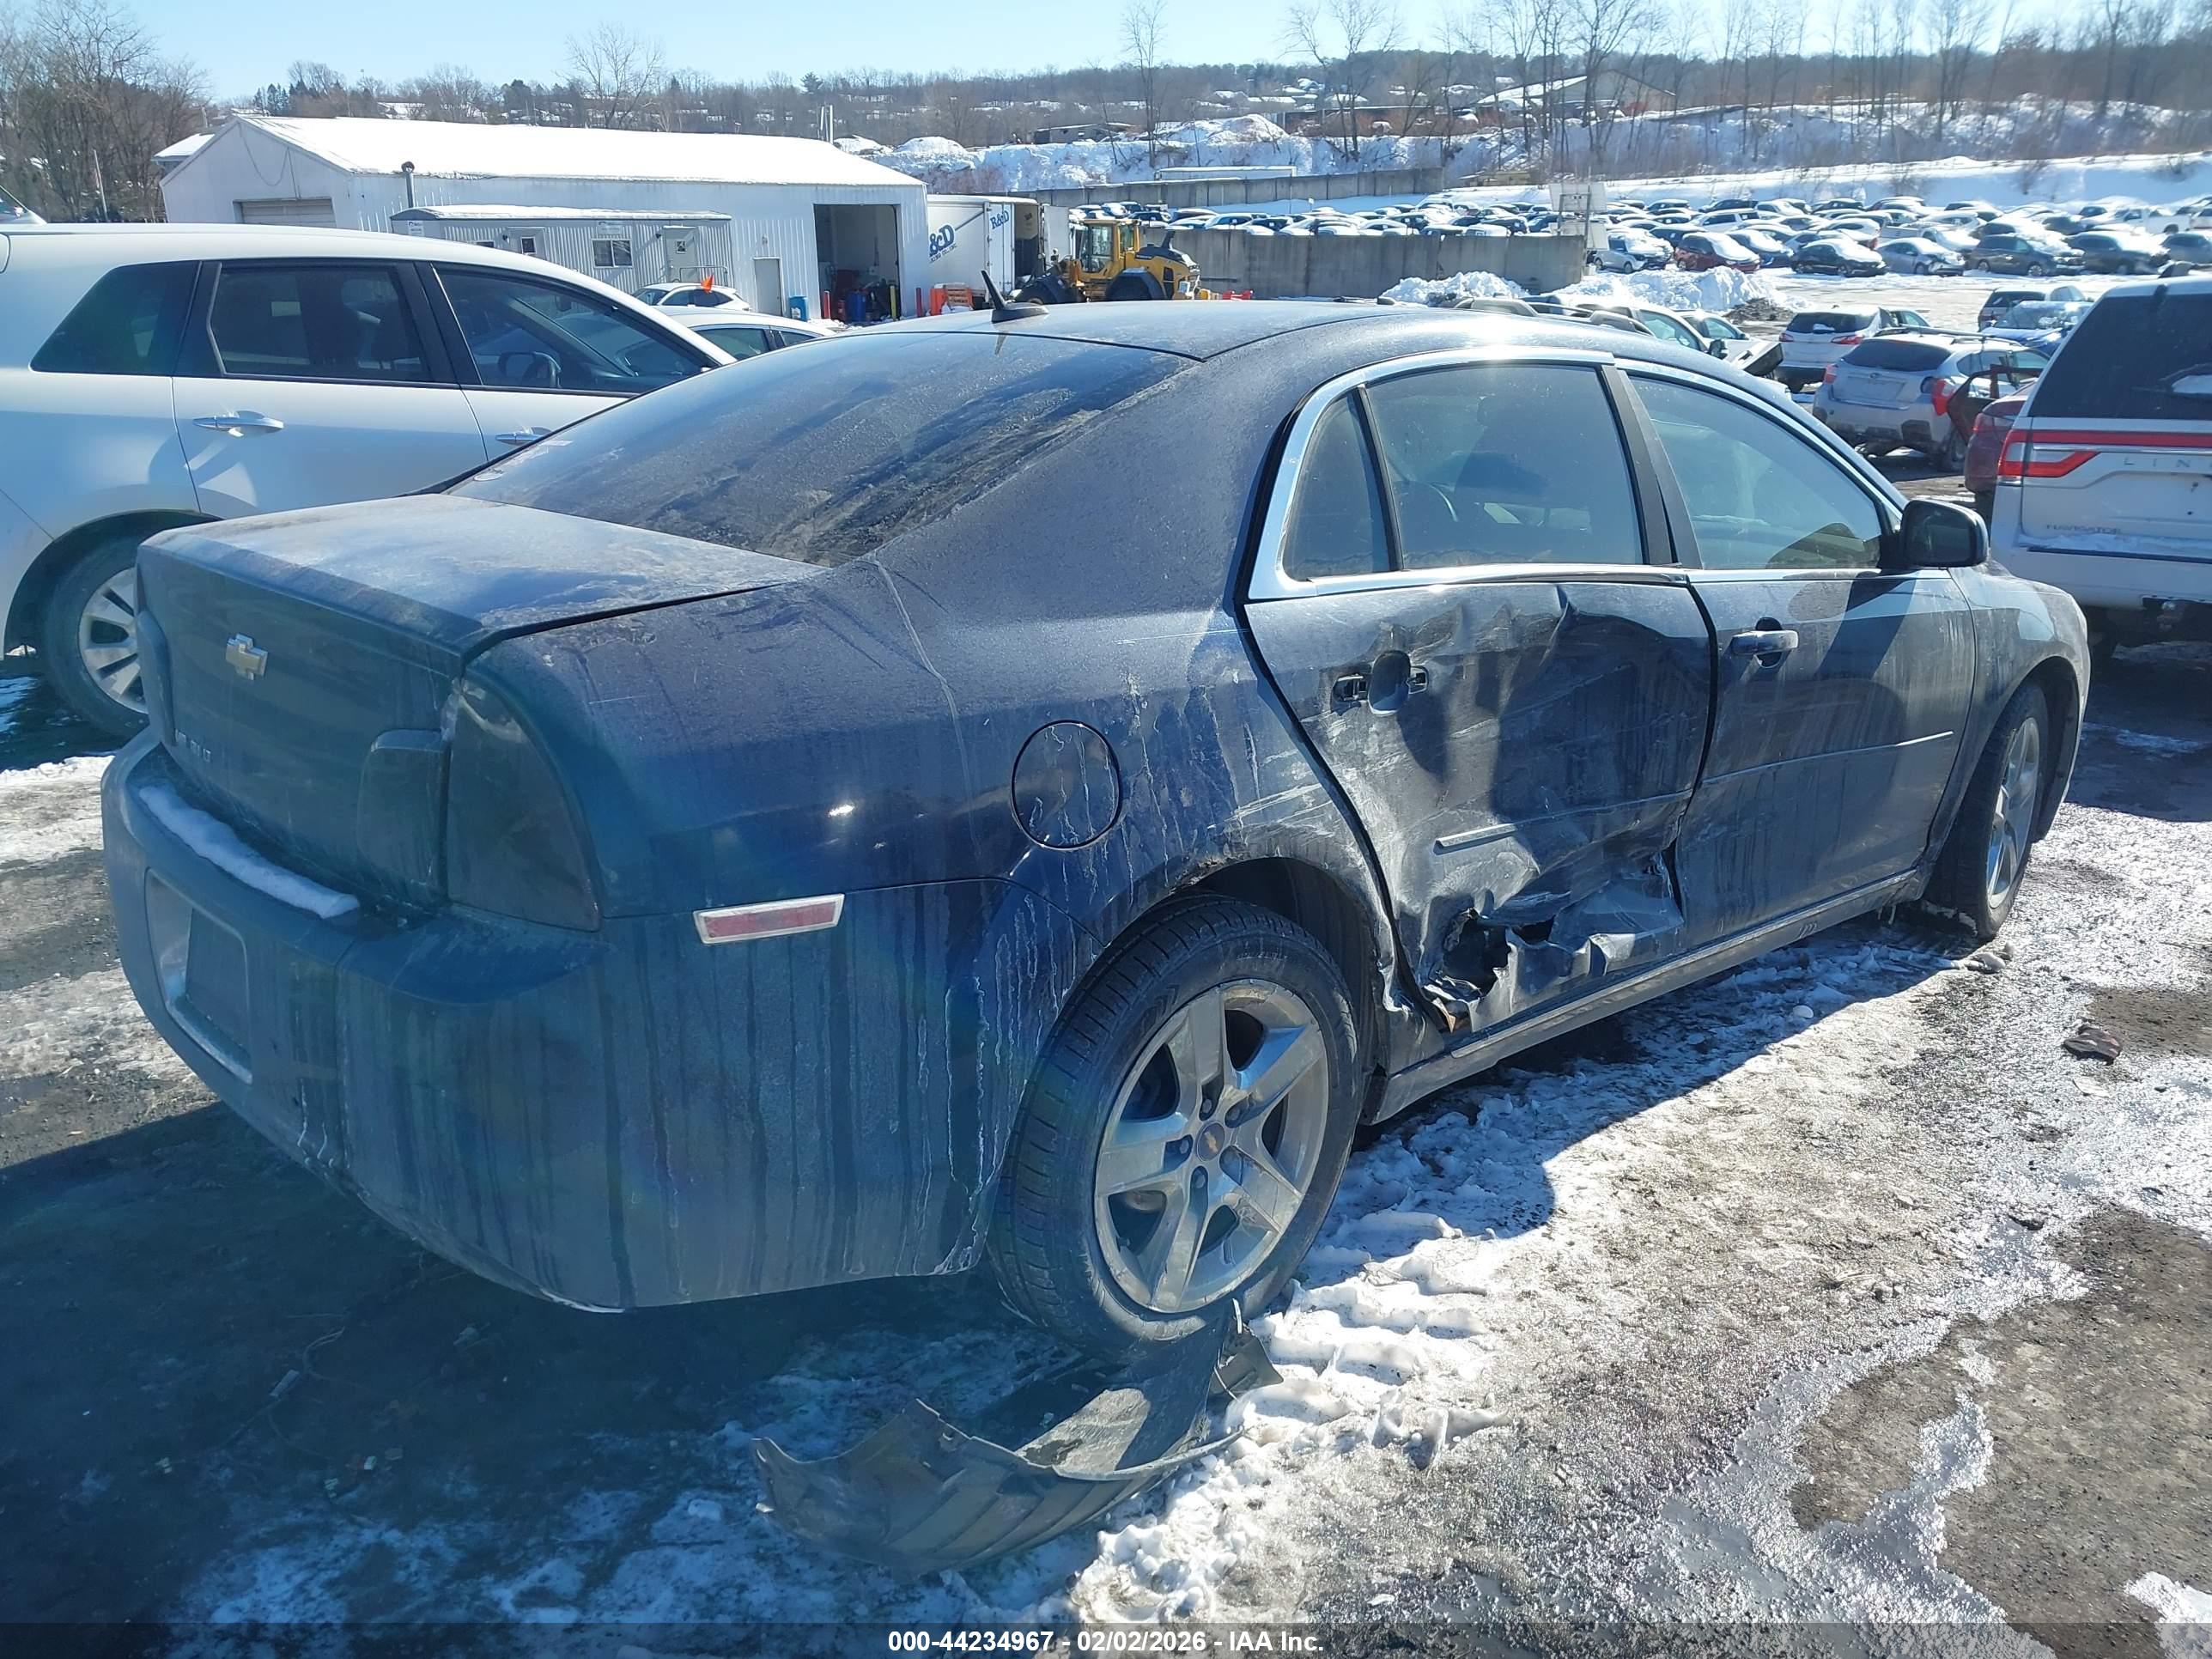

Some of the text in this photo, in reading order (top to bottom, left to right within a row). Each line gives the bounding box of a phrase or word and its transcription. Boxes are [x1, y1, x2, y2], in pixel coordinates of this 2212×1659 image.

[990, 210, 1010, 229] R&D
[928, 224, 955, 258] &D
[2124, 457, 2212, 468] LIN
